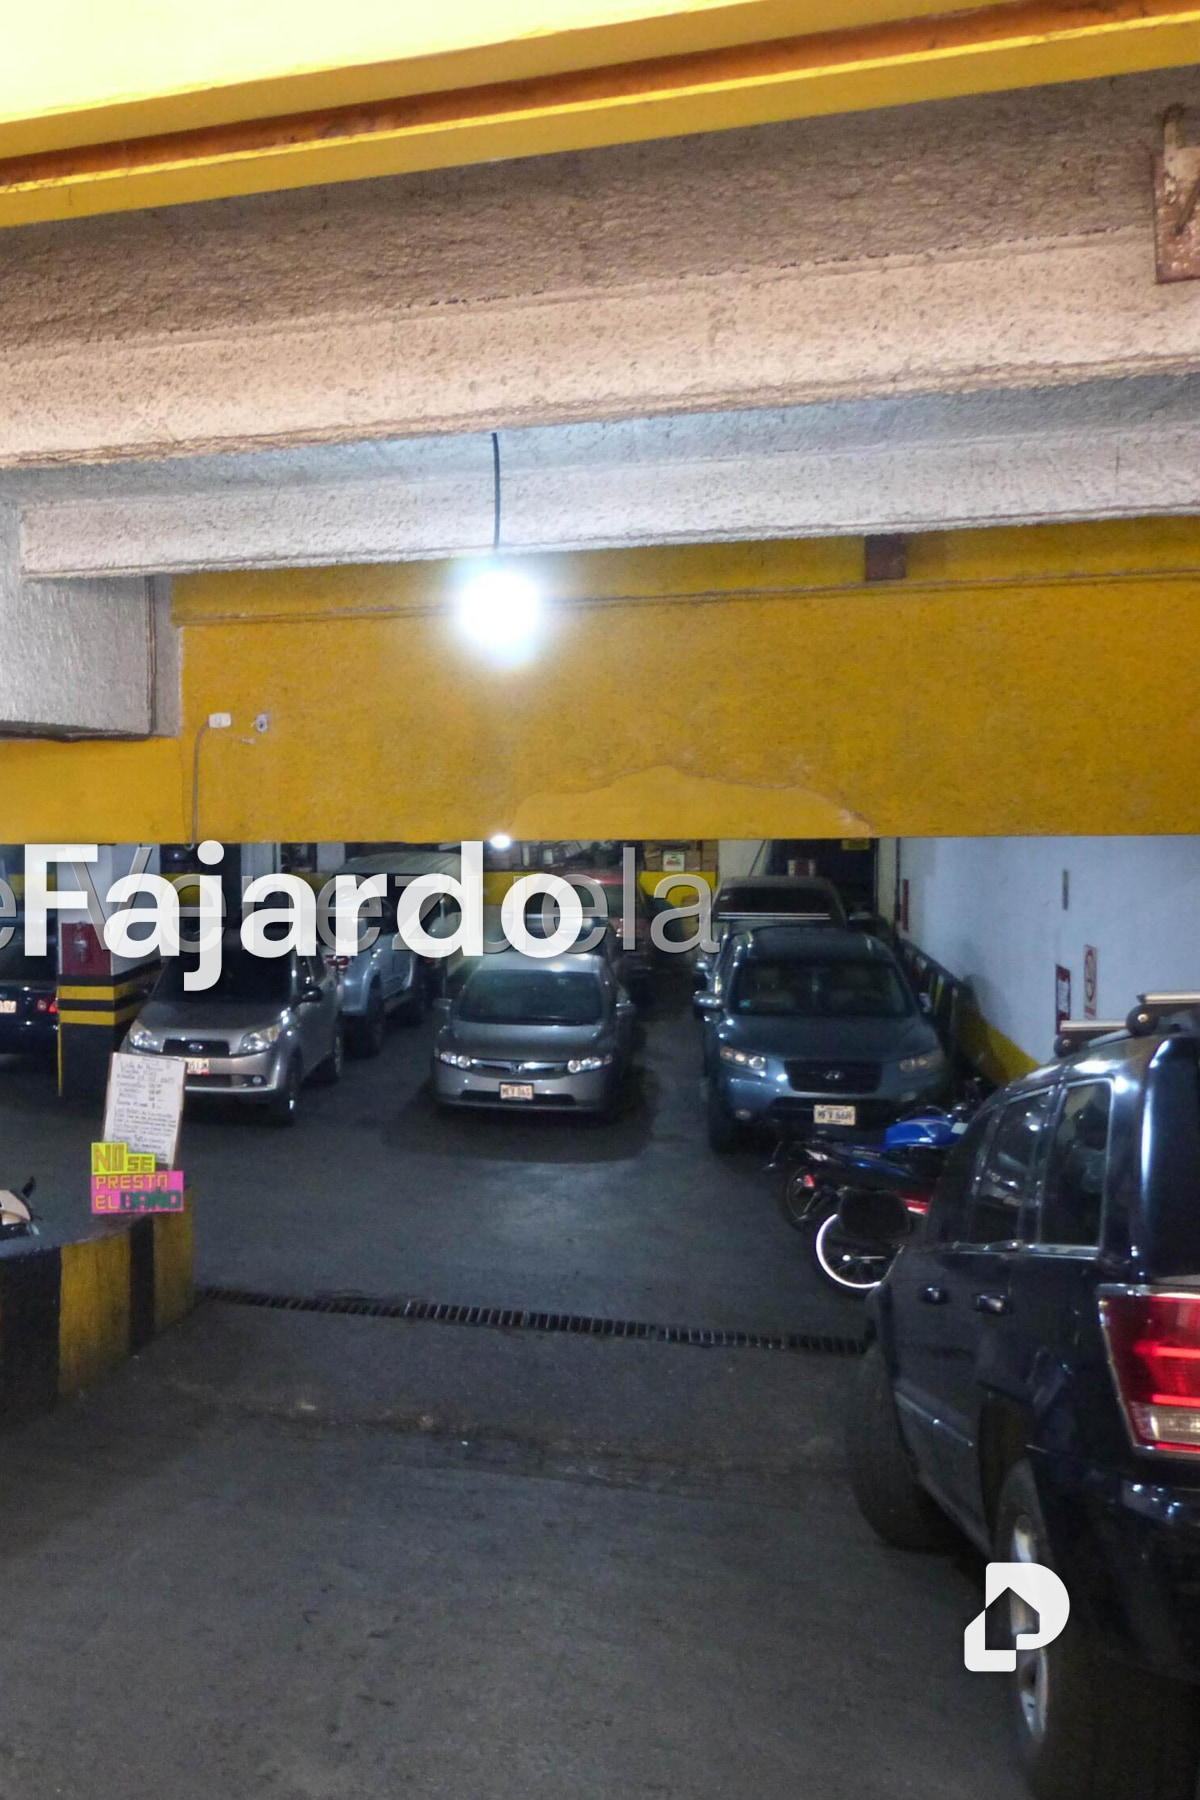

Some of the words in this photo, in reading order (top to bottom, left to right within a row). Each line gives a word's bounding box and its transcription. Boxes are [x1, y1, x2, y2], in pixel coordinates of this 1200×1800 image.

[93, 1144, 125, 1172] NO
[127, 1156, 153, 1172] SE
[95, 1194, 119, 1210] EL
